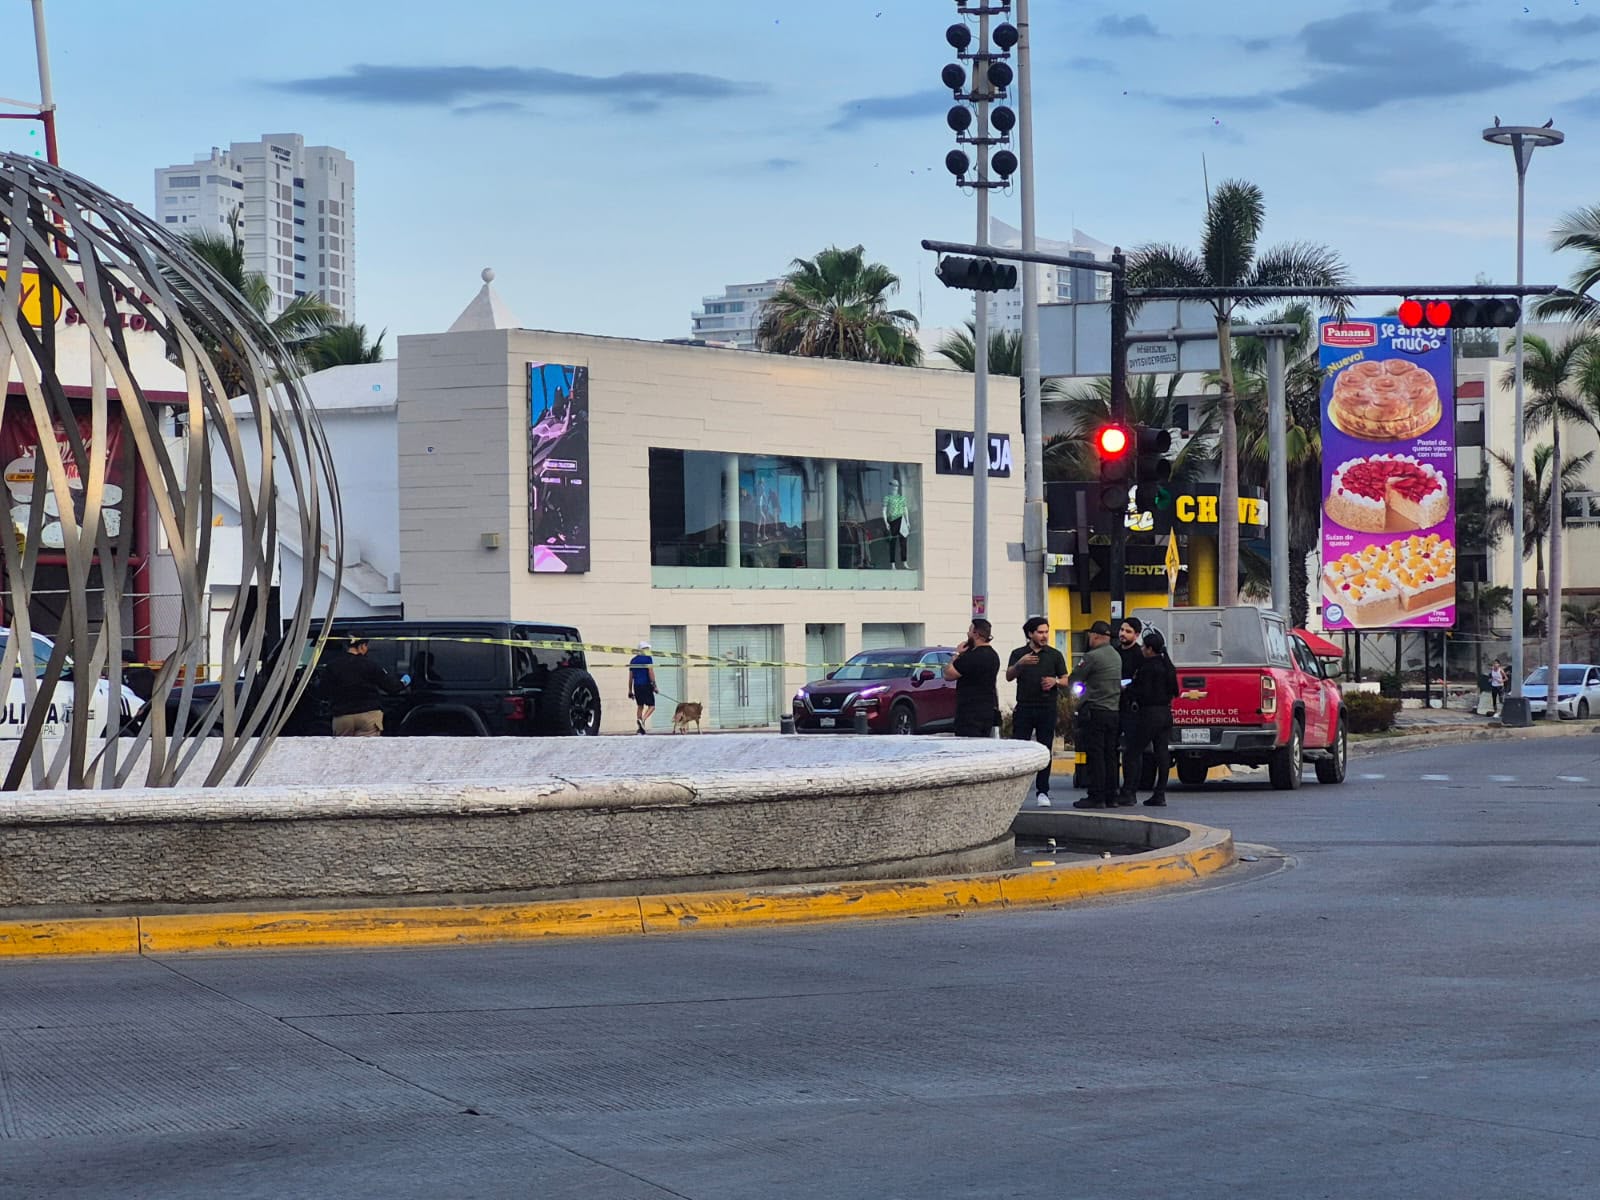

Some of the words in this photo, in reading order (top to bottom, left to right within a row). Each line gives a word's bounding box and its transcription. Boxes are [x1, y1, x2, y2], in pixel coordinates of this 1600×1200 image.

[1327, 327, 1371, 337] Panamá
[1391, 337, 1441, 352] mucho
[1327, 351, 1364, 377] ¡Nuevo!
[963, 437, 1012, 472] MJA
